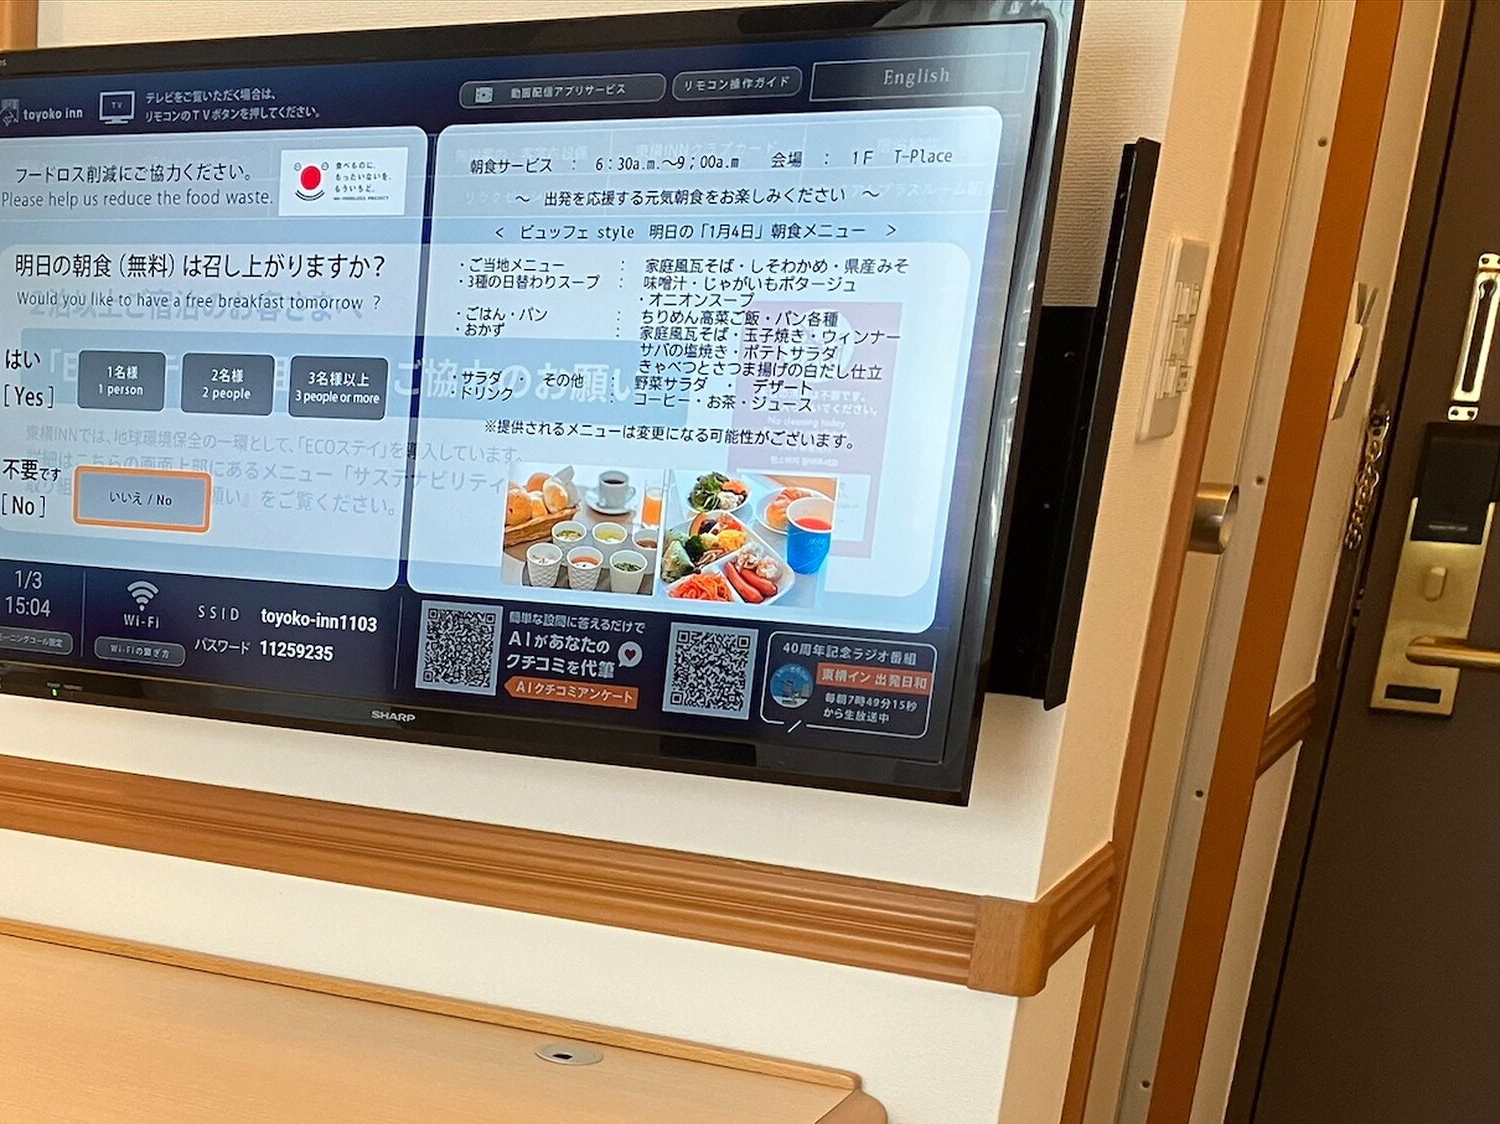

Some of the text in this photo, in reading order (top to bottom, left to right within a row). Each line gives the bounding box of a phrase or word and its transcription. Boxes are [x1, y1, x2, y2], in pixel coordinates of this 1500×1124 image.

[684, 75, 790, 92] リモコン操作ガイド
[884, 68, 950, 88] English
[23, 107, 83, 123] toyoko inn
[470, 159, 552, 174] 朝食サービス
[771, 152, 803, 168] 会場
[894, 149, 953, 164] T-Place
[16, 163, 252, 183] フードロス削減にご協力ください。
[2, 189, 274, 210] Please help us reduce the food waste.
[520, 224, 589, 241] ビュッフェ
[597, 224, 634, 241] style
[17, 290, 58, 306] Would
[62, 294, 86, 309] you
[91, 291, 115, 307] like
[119, 294, 132, 307] to
[136, 293, 170, 308] have
[173, 298, 180, 308] a
[186, 293, 213, 308] free
[218, 293, 284, 310] breakfast
[290, 296, 364, 311] tomorrow
[5, 349, 42, 370] はい
[107, 365, 138, 380] 1名様
[211, 368, 244, 384] 2名様
[308, 371, 370, 387] 3名様以上
[543, 373, 584, 388] その他
[107, 385, 143, 397] person
[203, 387, 251, 401] 2 people
[634, 375, 708, 391] 野菜サラダ
[753, 380, 813, 396] デザート
[296, 391, 380, 405] 3 people or more
[2, 459, 62, 482] 不要です
[156, 493, 172, 506] No
[15, 570, 43, 590] 1/3
[5, 596, 51, 617] 15:04
[124, 614, 160, 629] Wi-Fi
[261, 608, 378, 632] toyoko-inn1103
[194, 637, 334, 661] パスワード 11259235
[508, 630, 610, 654] AIがあなたの
[783, 642, 917, 666] 40周年記念ラジオ番組
[506, 653, 616, 678] クチコミを代筆
[821, 667, 928, 690] 東横イン 出発日和
[516, 681, 634, 704] AIクチコミアンケート
[372, 710, 416, 722] SHARP
